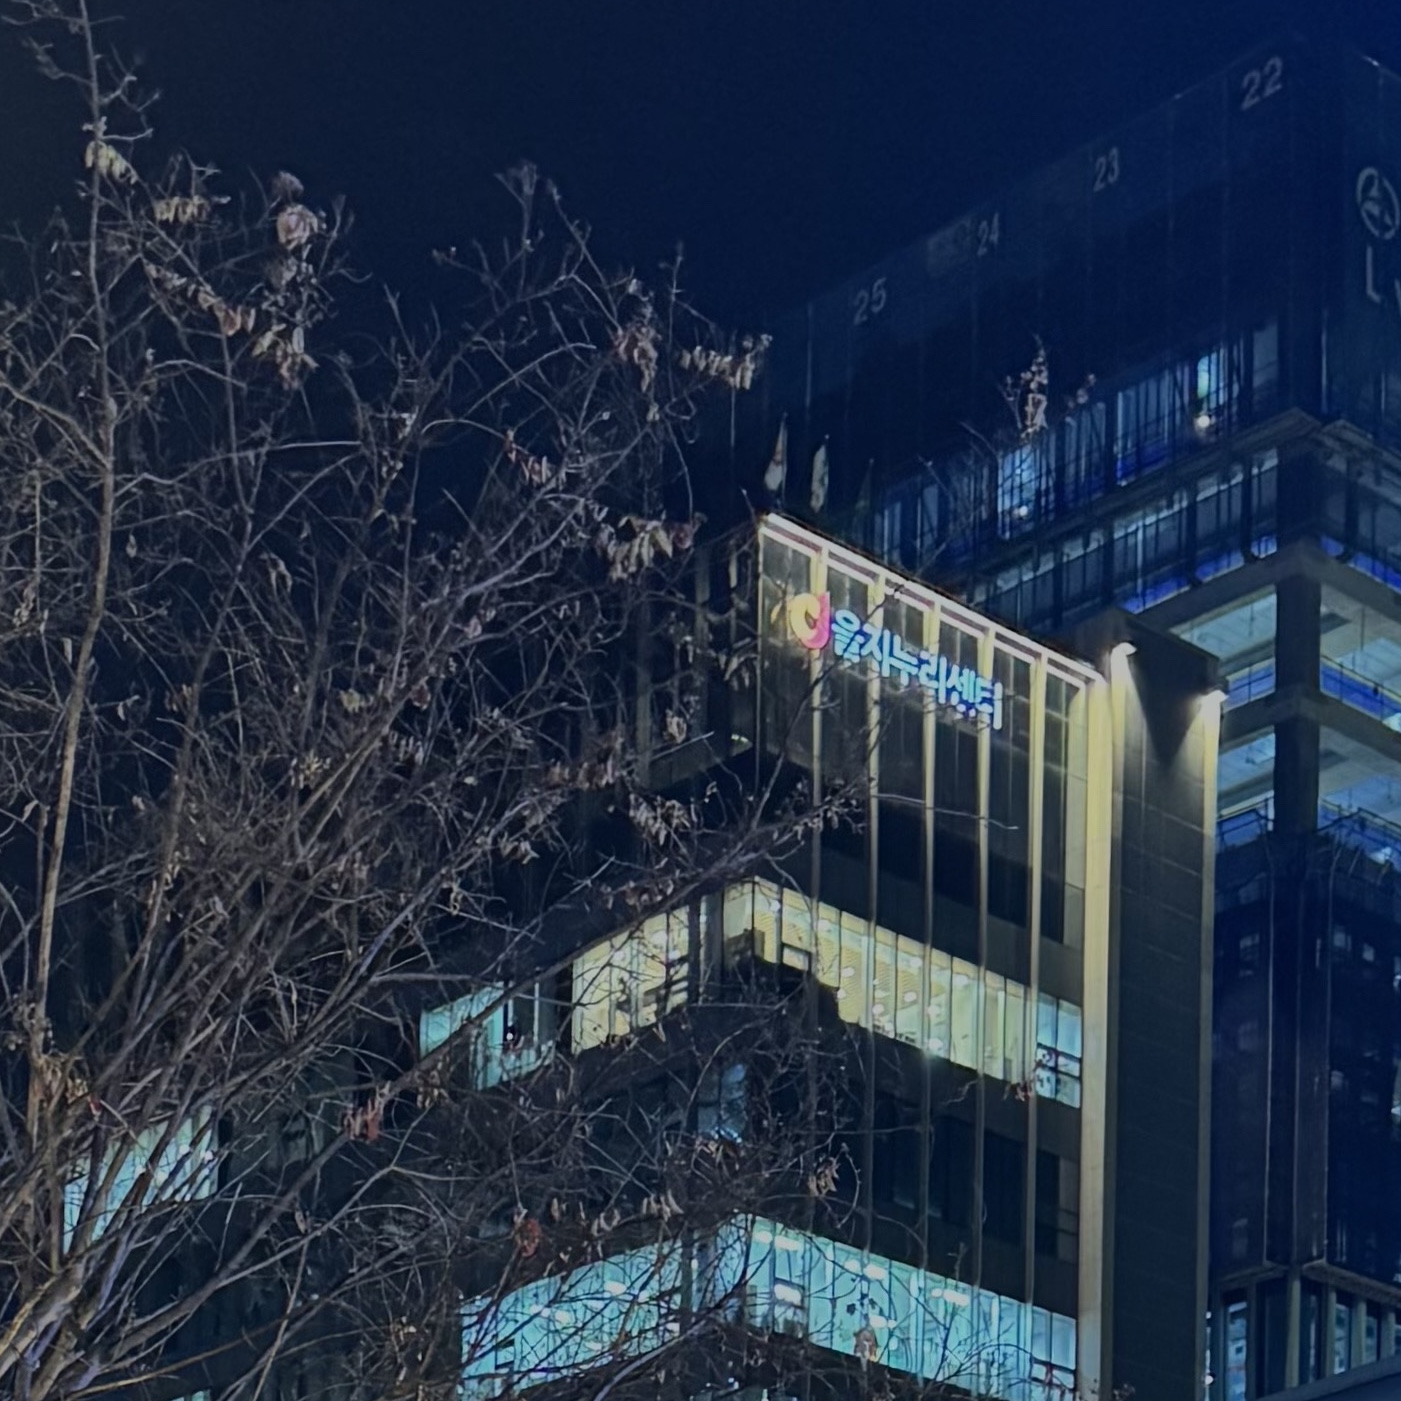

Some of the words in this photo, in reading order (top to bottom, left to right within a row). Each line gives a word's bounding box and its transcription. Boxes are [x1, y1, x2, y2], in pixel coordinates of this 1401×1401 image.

[1240, 56, 1284, 111] 22
[1093, 147, 1120, 193] 23
[977, 212, 1000, 257] 24
[854, 277, 887, 325] 25
[831, 608, 1003, 730] 을지누리센터
